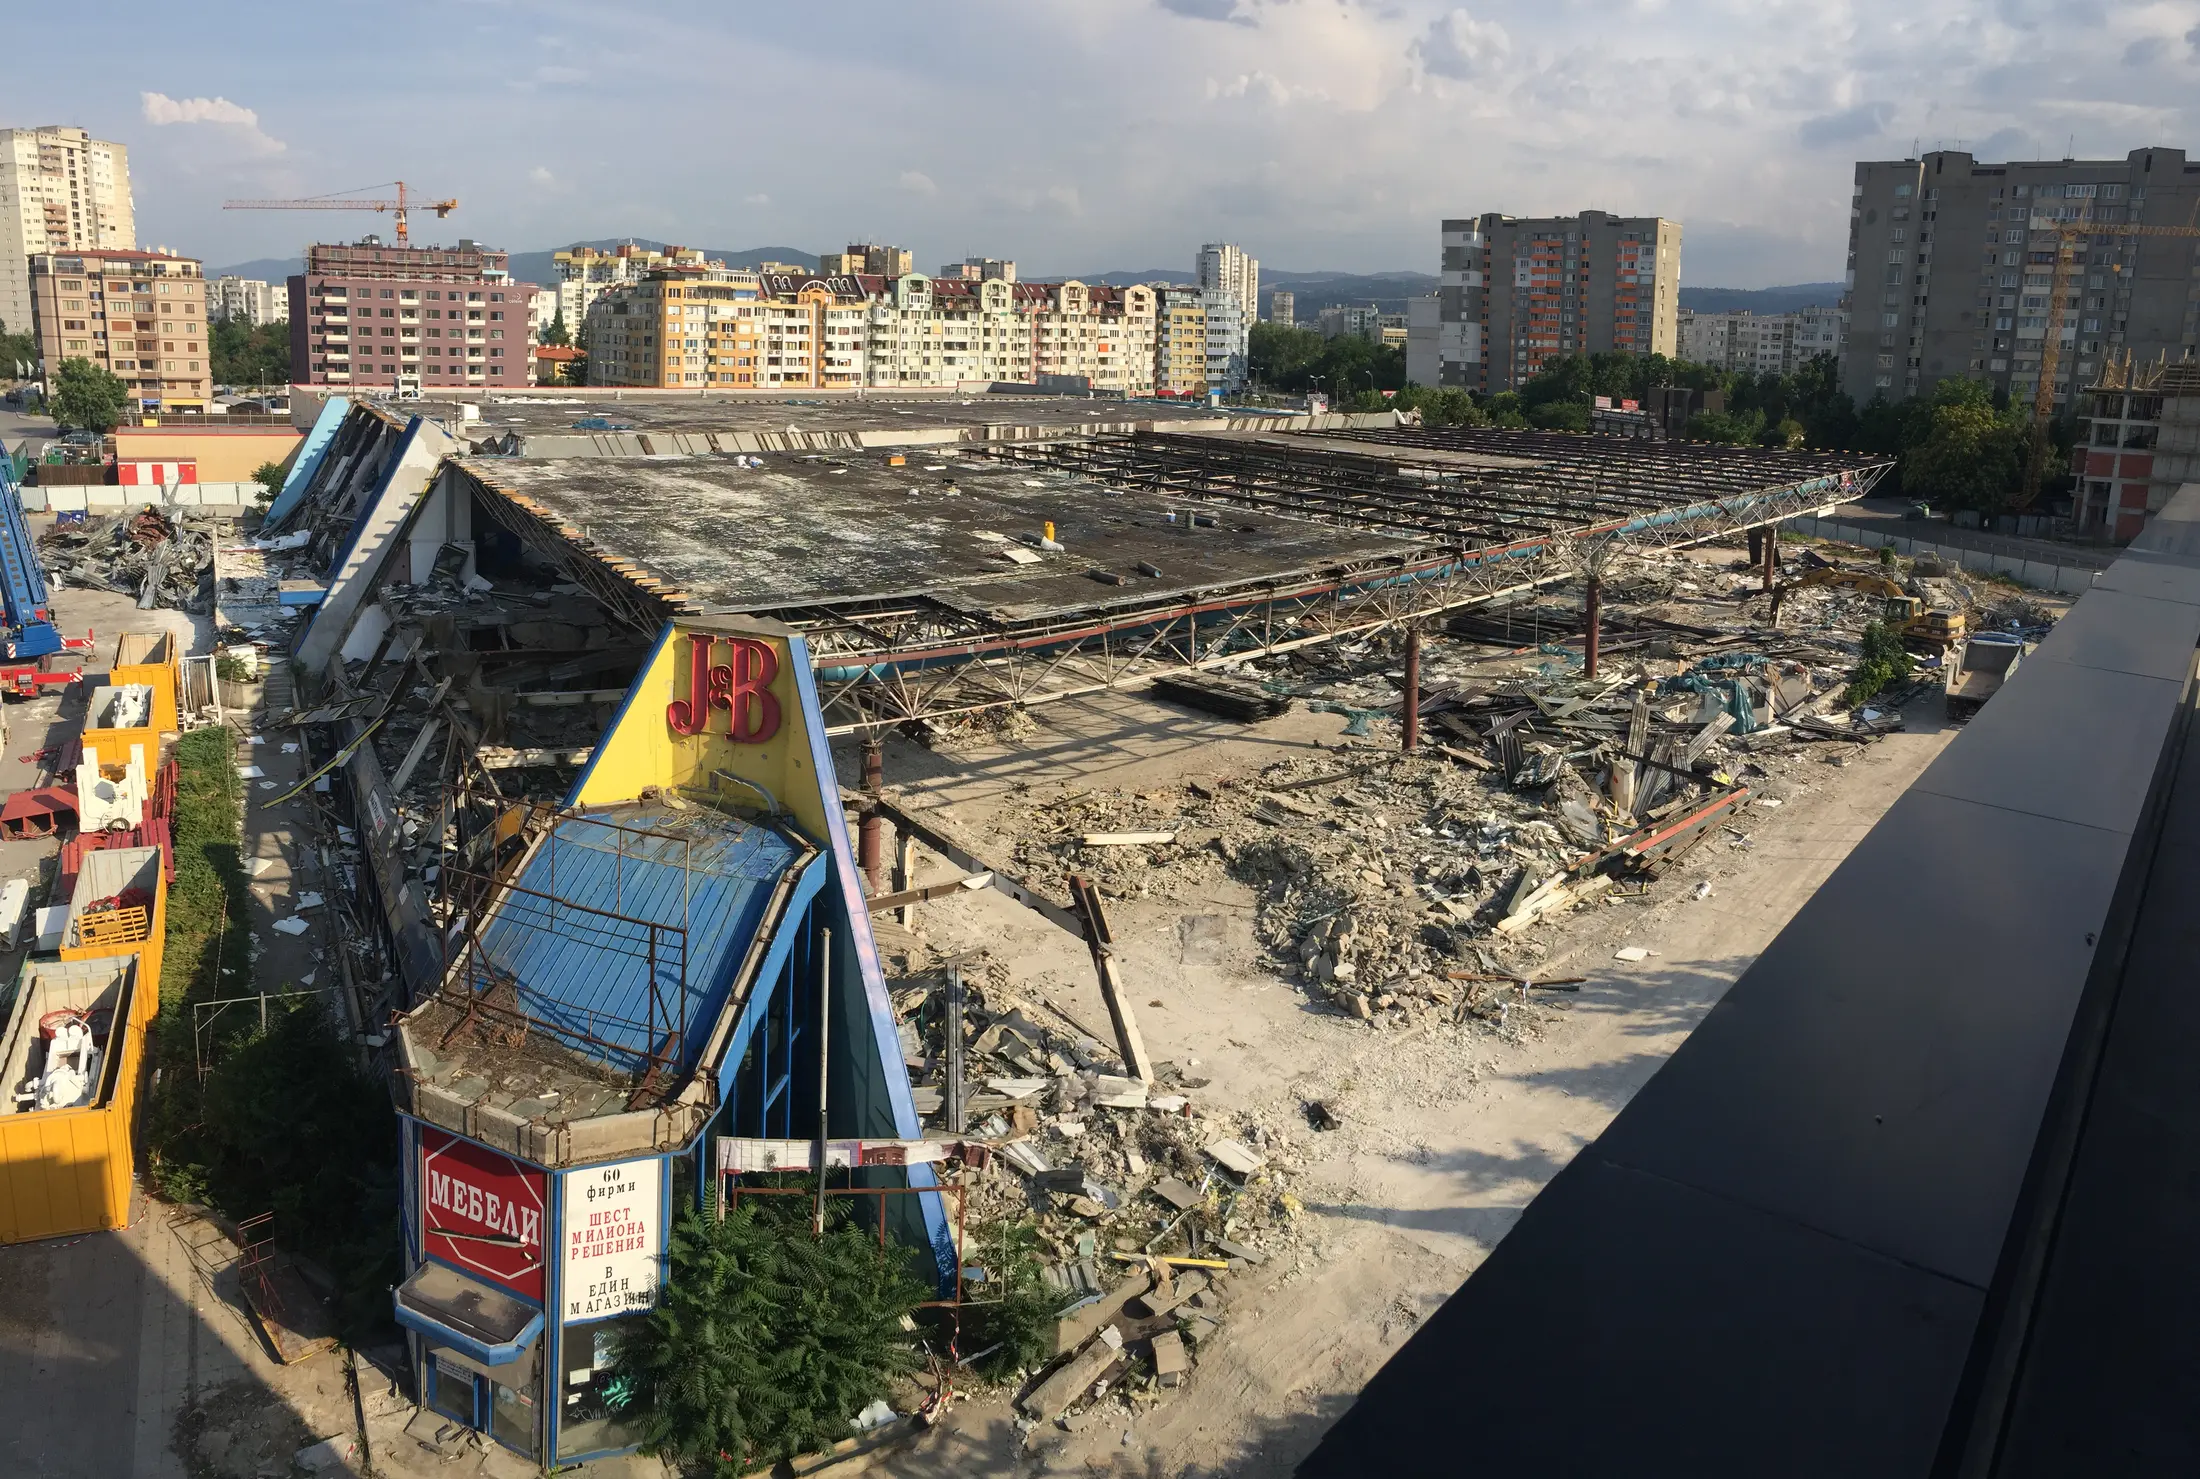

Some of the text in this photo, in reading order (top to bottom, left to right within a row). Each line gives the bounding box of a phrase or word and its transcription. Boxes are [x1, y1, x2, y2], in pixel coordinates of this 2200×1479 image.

[603, 1168, 620, 1182] 60
[587, 1181, 635, 1202] фирми
[431, 1169, 540, 1246] МЕБЕЛИ
[589, 1207, 630, 1227] ШЕСТ
[572, 1221, 645, 1245] МИЛИОНА
[571, 1236, 645, 1260] РЕШЕНИЯ
[605, 1266, 613, 1279] В
[589, 1278, 629, 1297] ЕДИН
